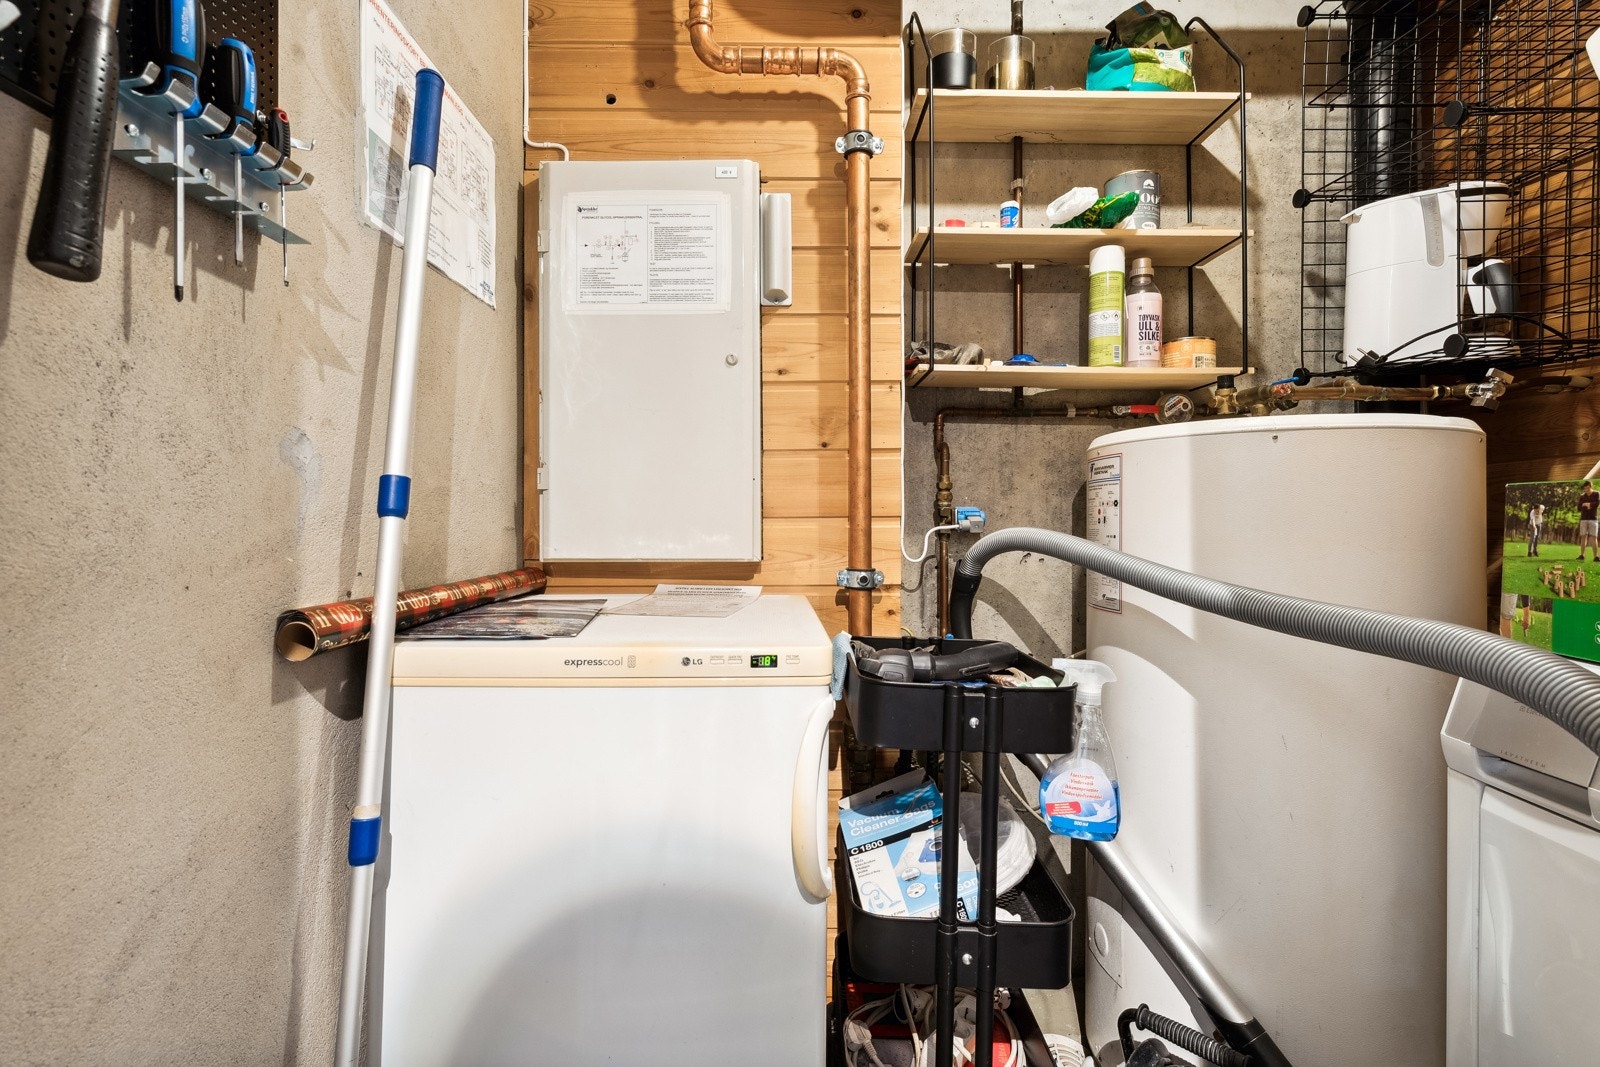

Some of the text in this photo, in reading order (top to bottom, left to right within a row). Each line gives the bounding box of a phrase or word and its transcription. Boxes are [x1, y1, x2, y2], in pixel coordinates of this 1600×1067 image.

[1138, 321, 1160, 331] ULL &
[1138, 331, 1160, 341] SILKE
[564, 656, 623, 668] expresscool
[847, 808, 900, 828] Vacuum
[850, 800, 936, 837] Cleaner Bags
[851, 840, 884, 855] C 1800
